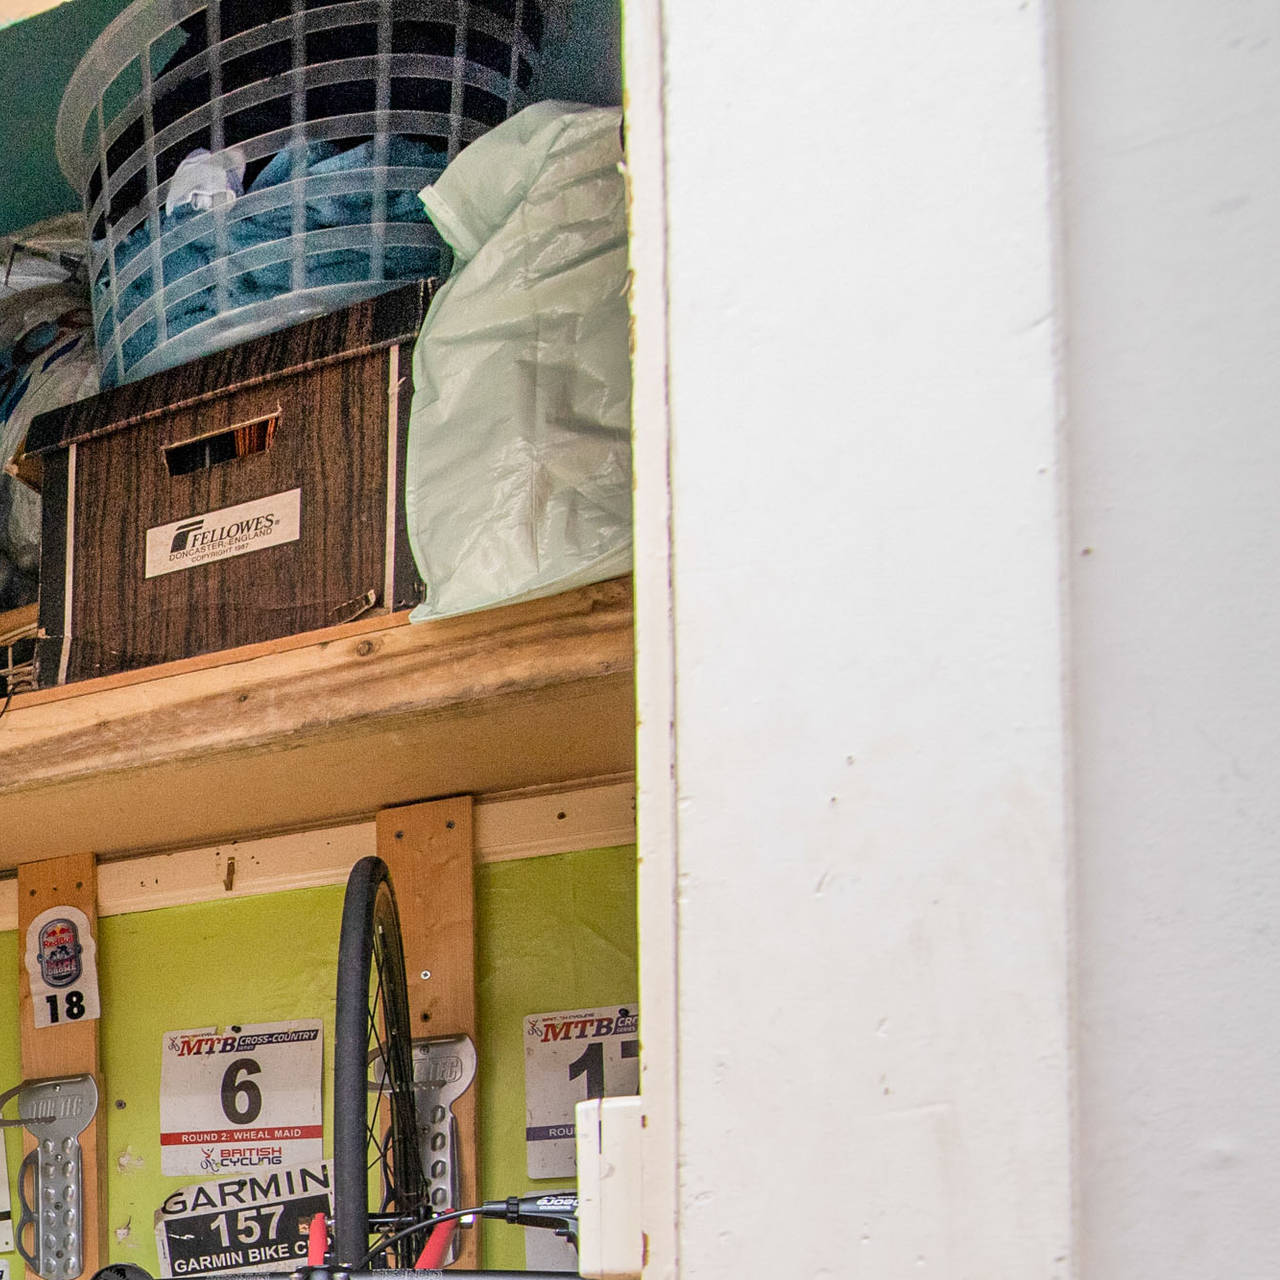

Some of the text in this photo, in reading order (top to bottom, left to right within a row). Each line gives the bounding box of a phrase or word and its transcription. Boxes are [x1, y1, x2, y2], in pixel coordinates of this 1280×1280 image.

[191, 513, 274, 548] FELLOWES
[228, 527, 273, 546] ENGLAND
[45, 990, 86, 1023] 18
[541, 1016, 614, 1042] MTB
[178, 1031, 317, 1057] MTB CROSS-COUNTRY
[220, 1058, 262, 1125] 6
[181, 1129, 302, 1142] ROUND 2: WHEAL MAID
[548, 1127, 575, 1137] ROU
[220, 1146, 282, 1158] BRITISH
[220, 1156, 282, 1167] CYCLING
[161, 1164, 330, 1215] GARMIN
[210, 1204, 286, 1247] 157
[174, 1250, 244, 1273] GARMIN
[248, 1243, 290, 1263] BIKE
